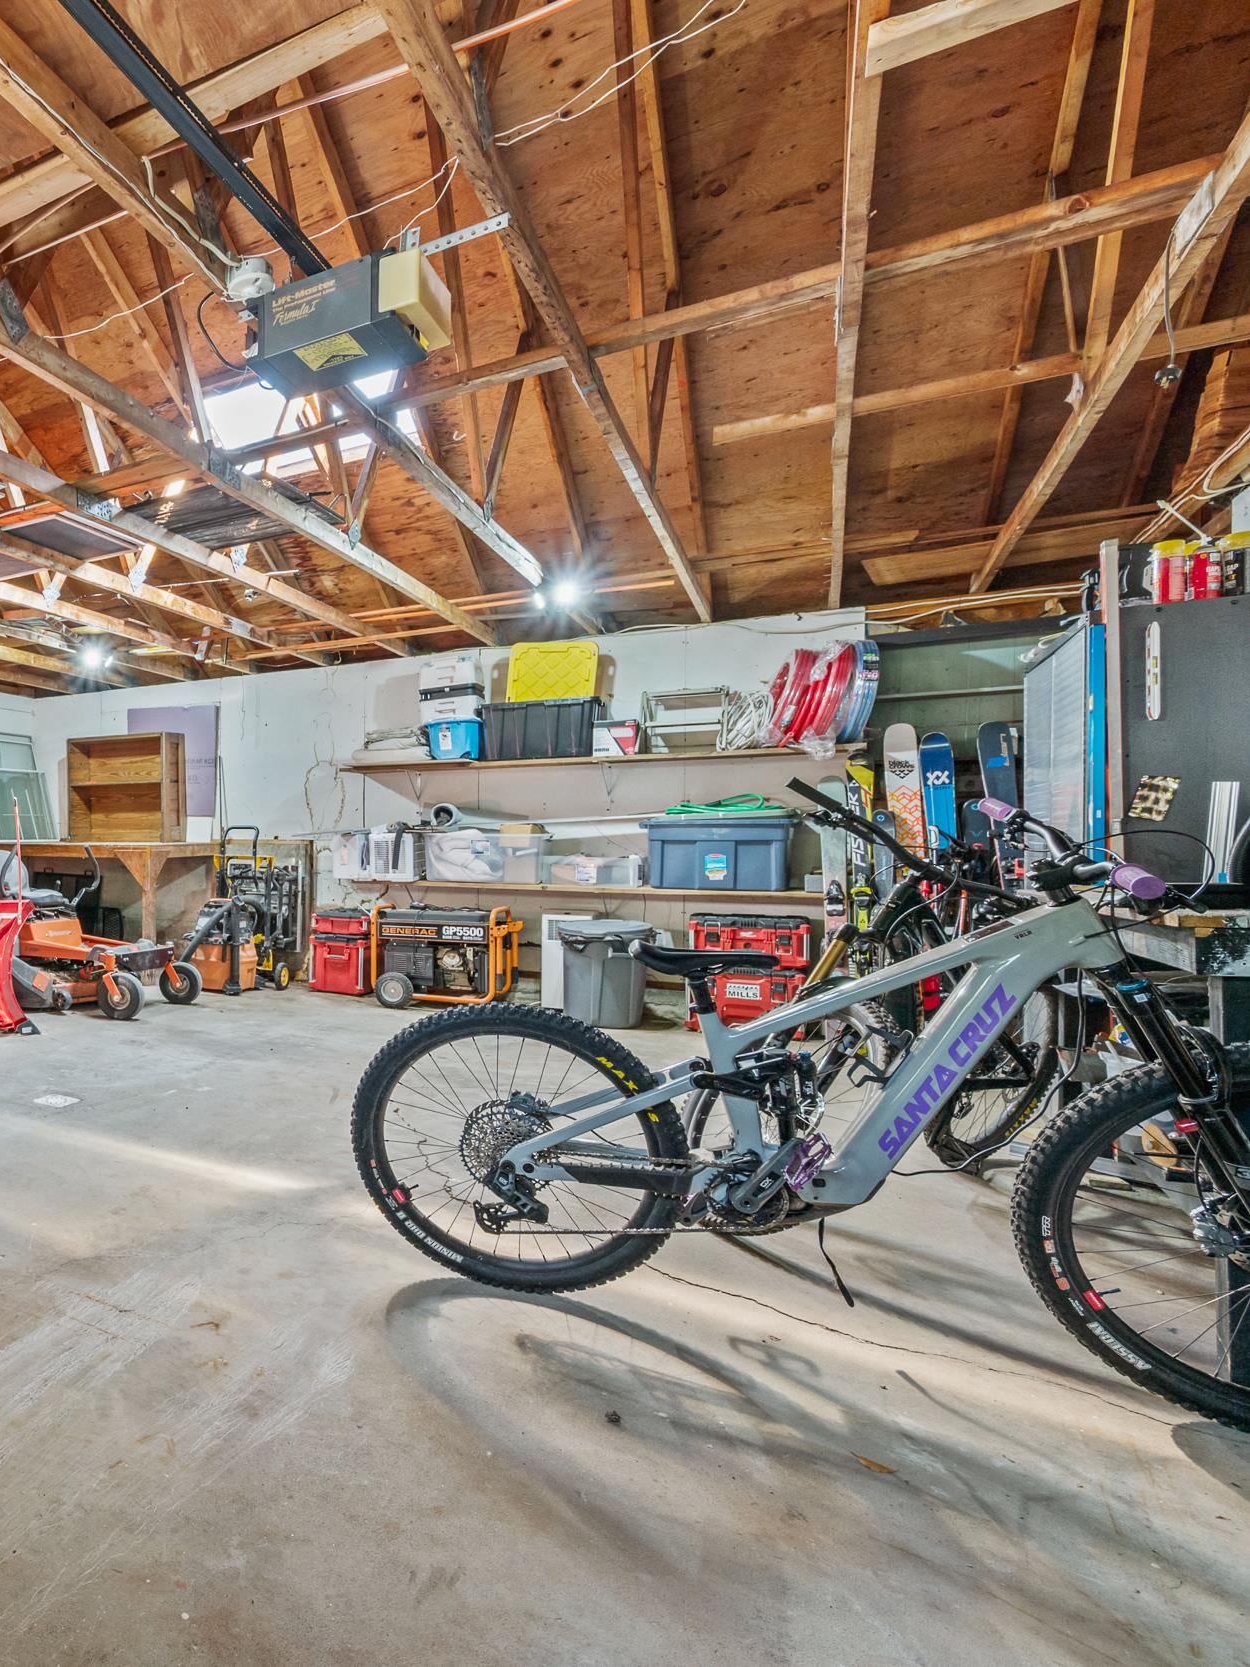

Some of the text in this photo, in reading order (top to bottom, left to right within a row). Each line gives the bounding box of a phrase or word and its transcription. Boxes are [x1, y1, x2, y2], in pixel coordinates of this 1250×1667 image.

[272, 280, 335, 307] Lift-Master
[272, 303, 310, 326] Formula
[848, 791, 867, 867] FISER
[382, 927, 436, 936] GENERAC
[442, 926, 484, 937] GP5500
[727, 990, 759, 999] MILLS
[878, 983, 1017, 1160] SANTA CRUZ
[595, 1056, 659, 1122] MAXS
[424, 1236, 464, 1263] MINION
